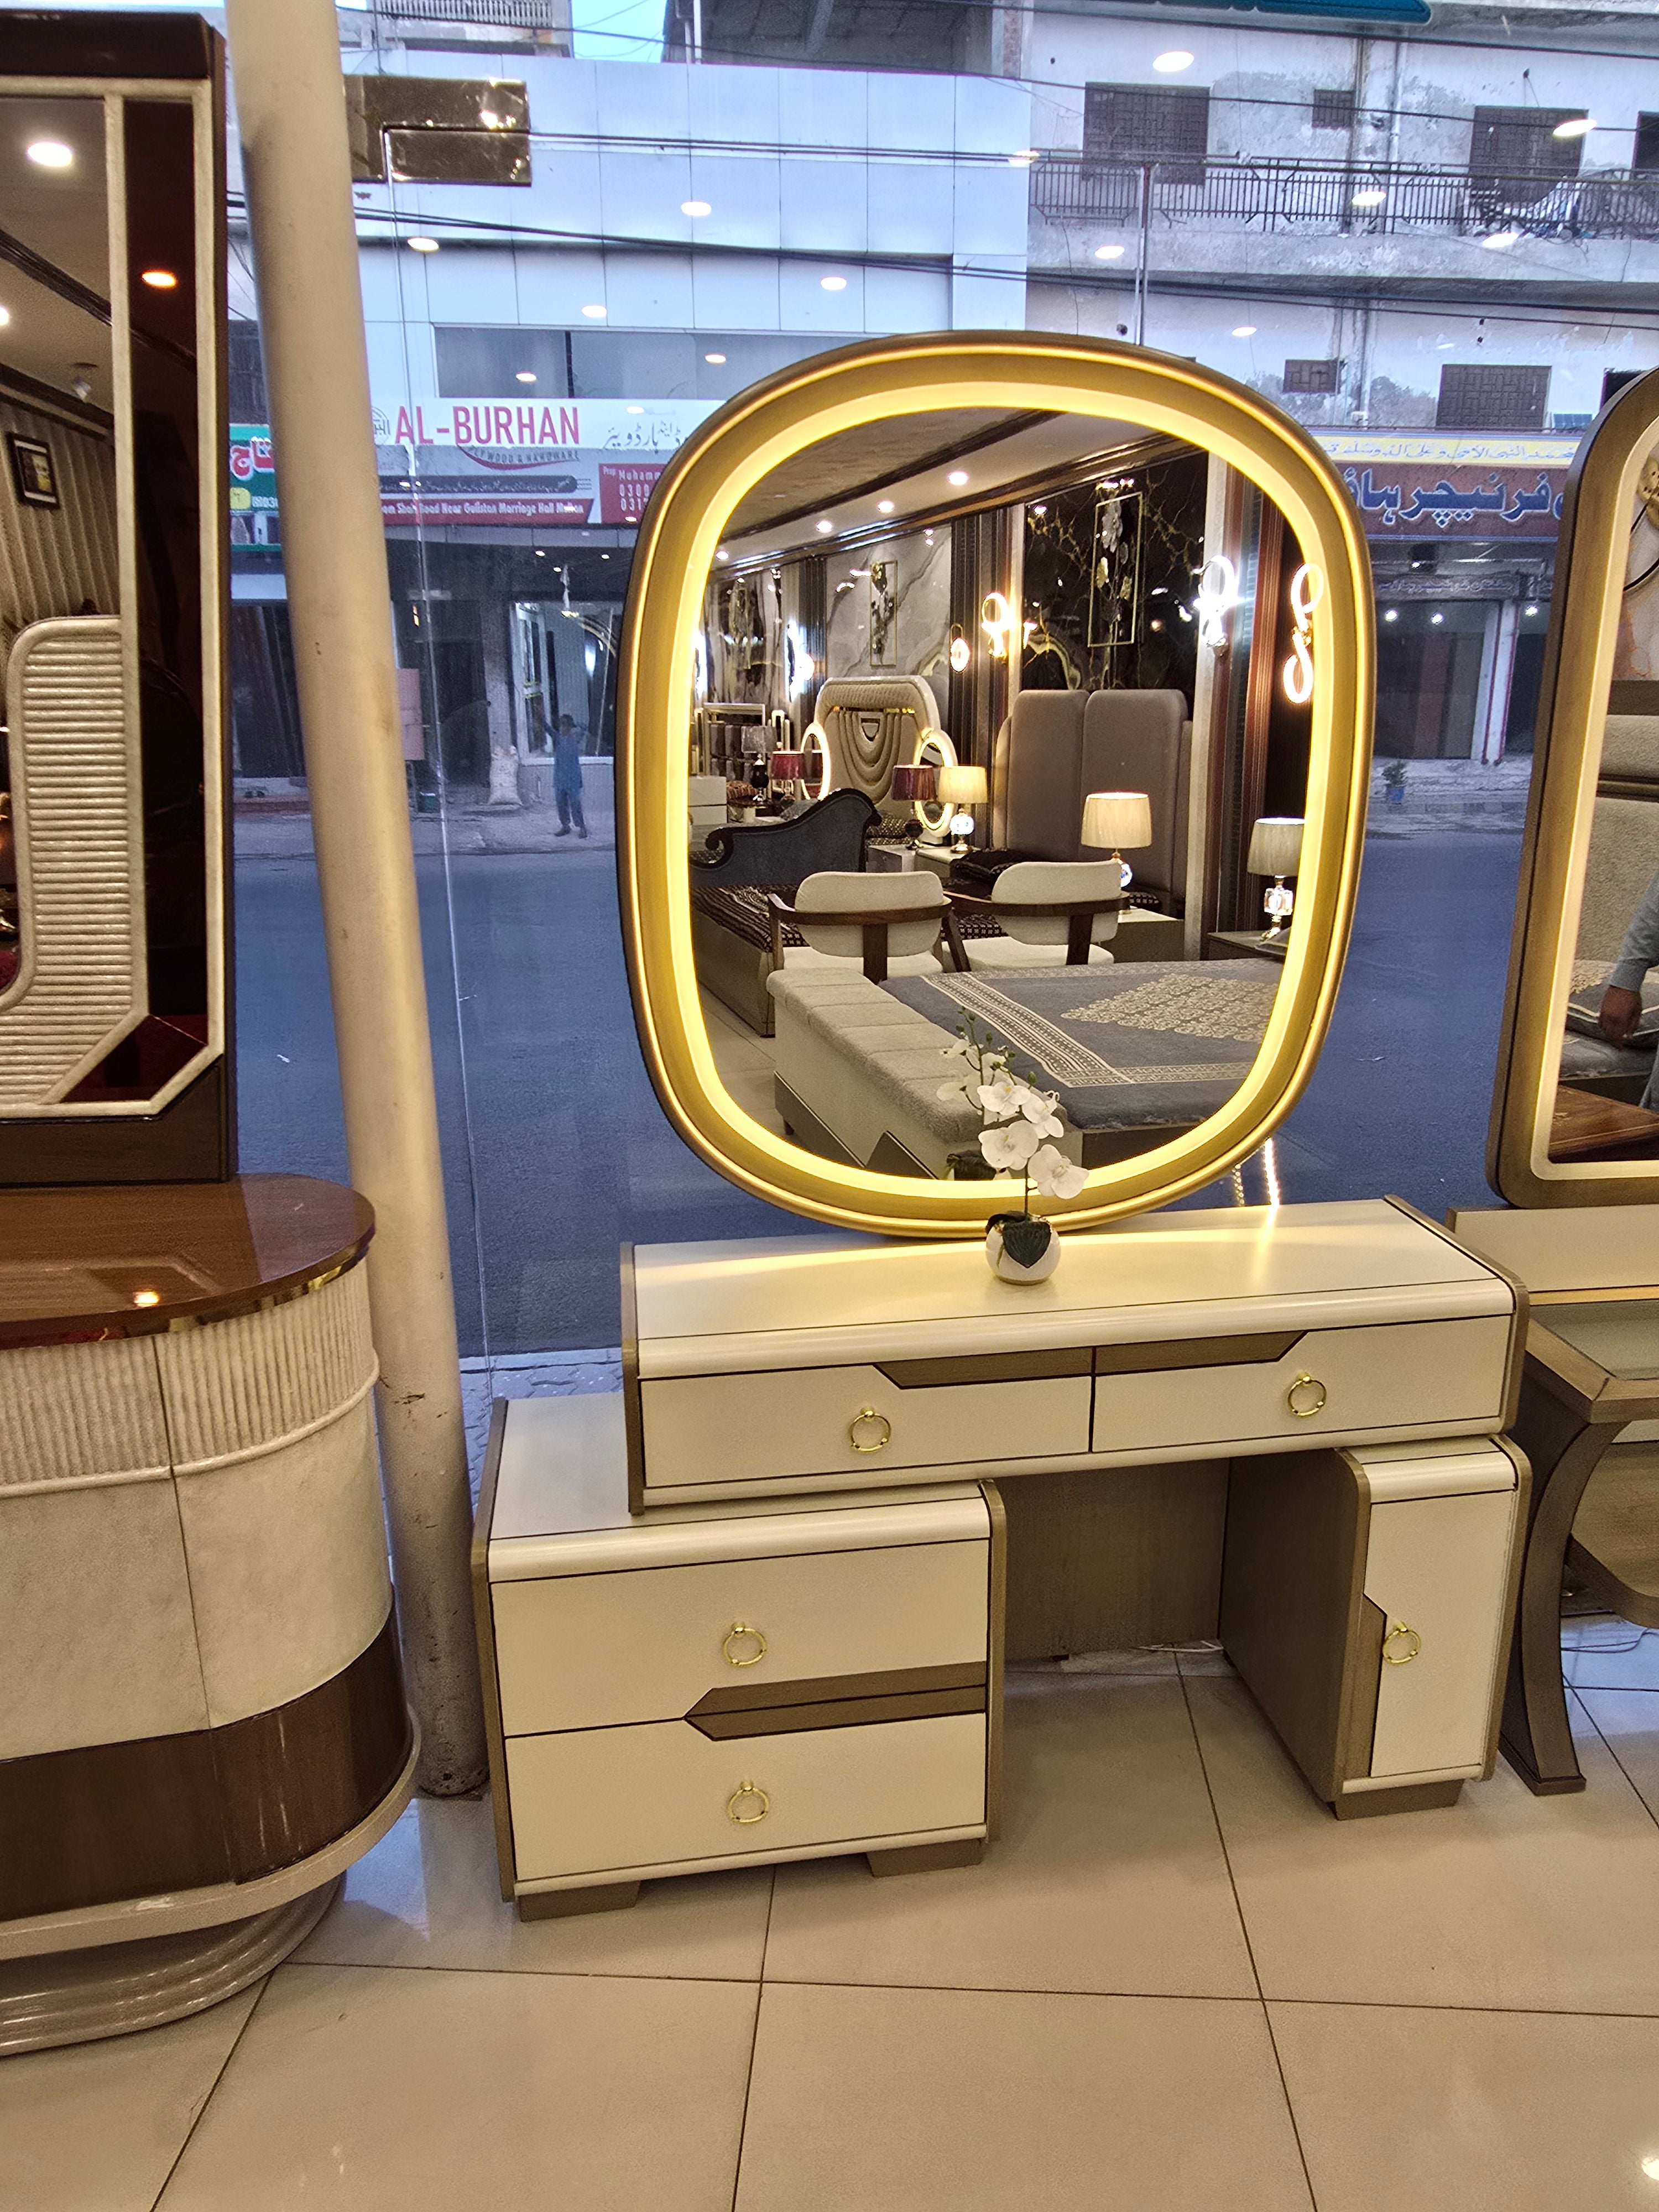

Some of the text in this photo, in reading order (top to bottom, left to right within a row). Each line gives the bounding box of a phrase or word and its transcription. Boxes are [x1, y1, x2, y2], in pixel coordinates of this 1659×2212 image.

[395, 405, 580, 444] AL-BURHAN
[619, 469, 661, 481] Muhamm
[1399, 471, 1551, 528] فرنیچر
